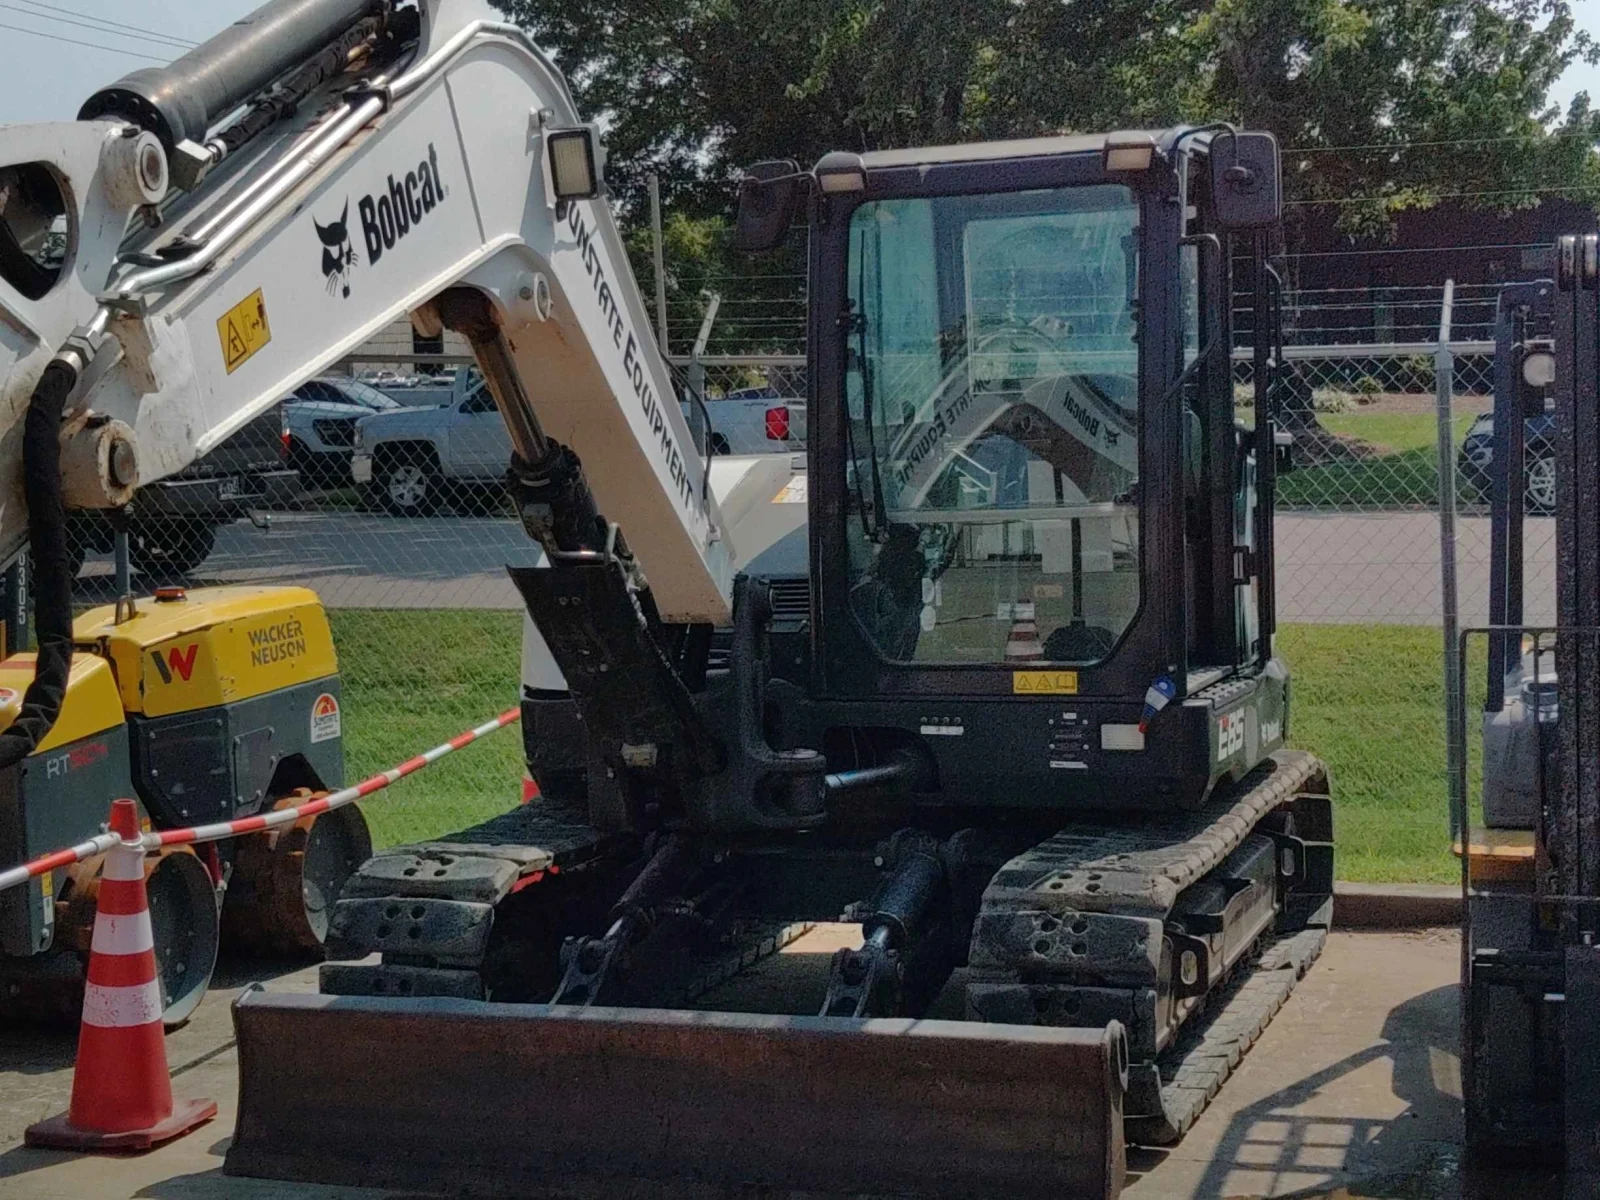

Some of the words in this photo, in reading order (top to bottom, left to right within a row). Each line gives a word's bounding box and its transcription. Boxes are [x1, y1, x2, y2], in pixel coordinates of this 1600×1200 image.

[358, 142, 445, 267] Bobcat
[568, 199, 624, 350] UNSTATE
[623, 329, 694, 509] EQUIPMENT
[247, 620, 304, 648] WACKER
[250, 638, 306, 668] NEUSON
